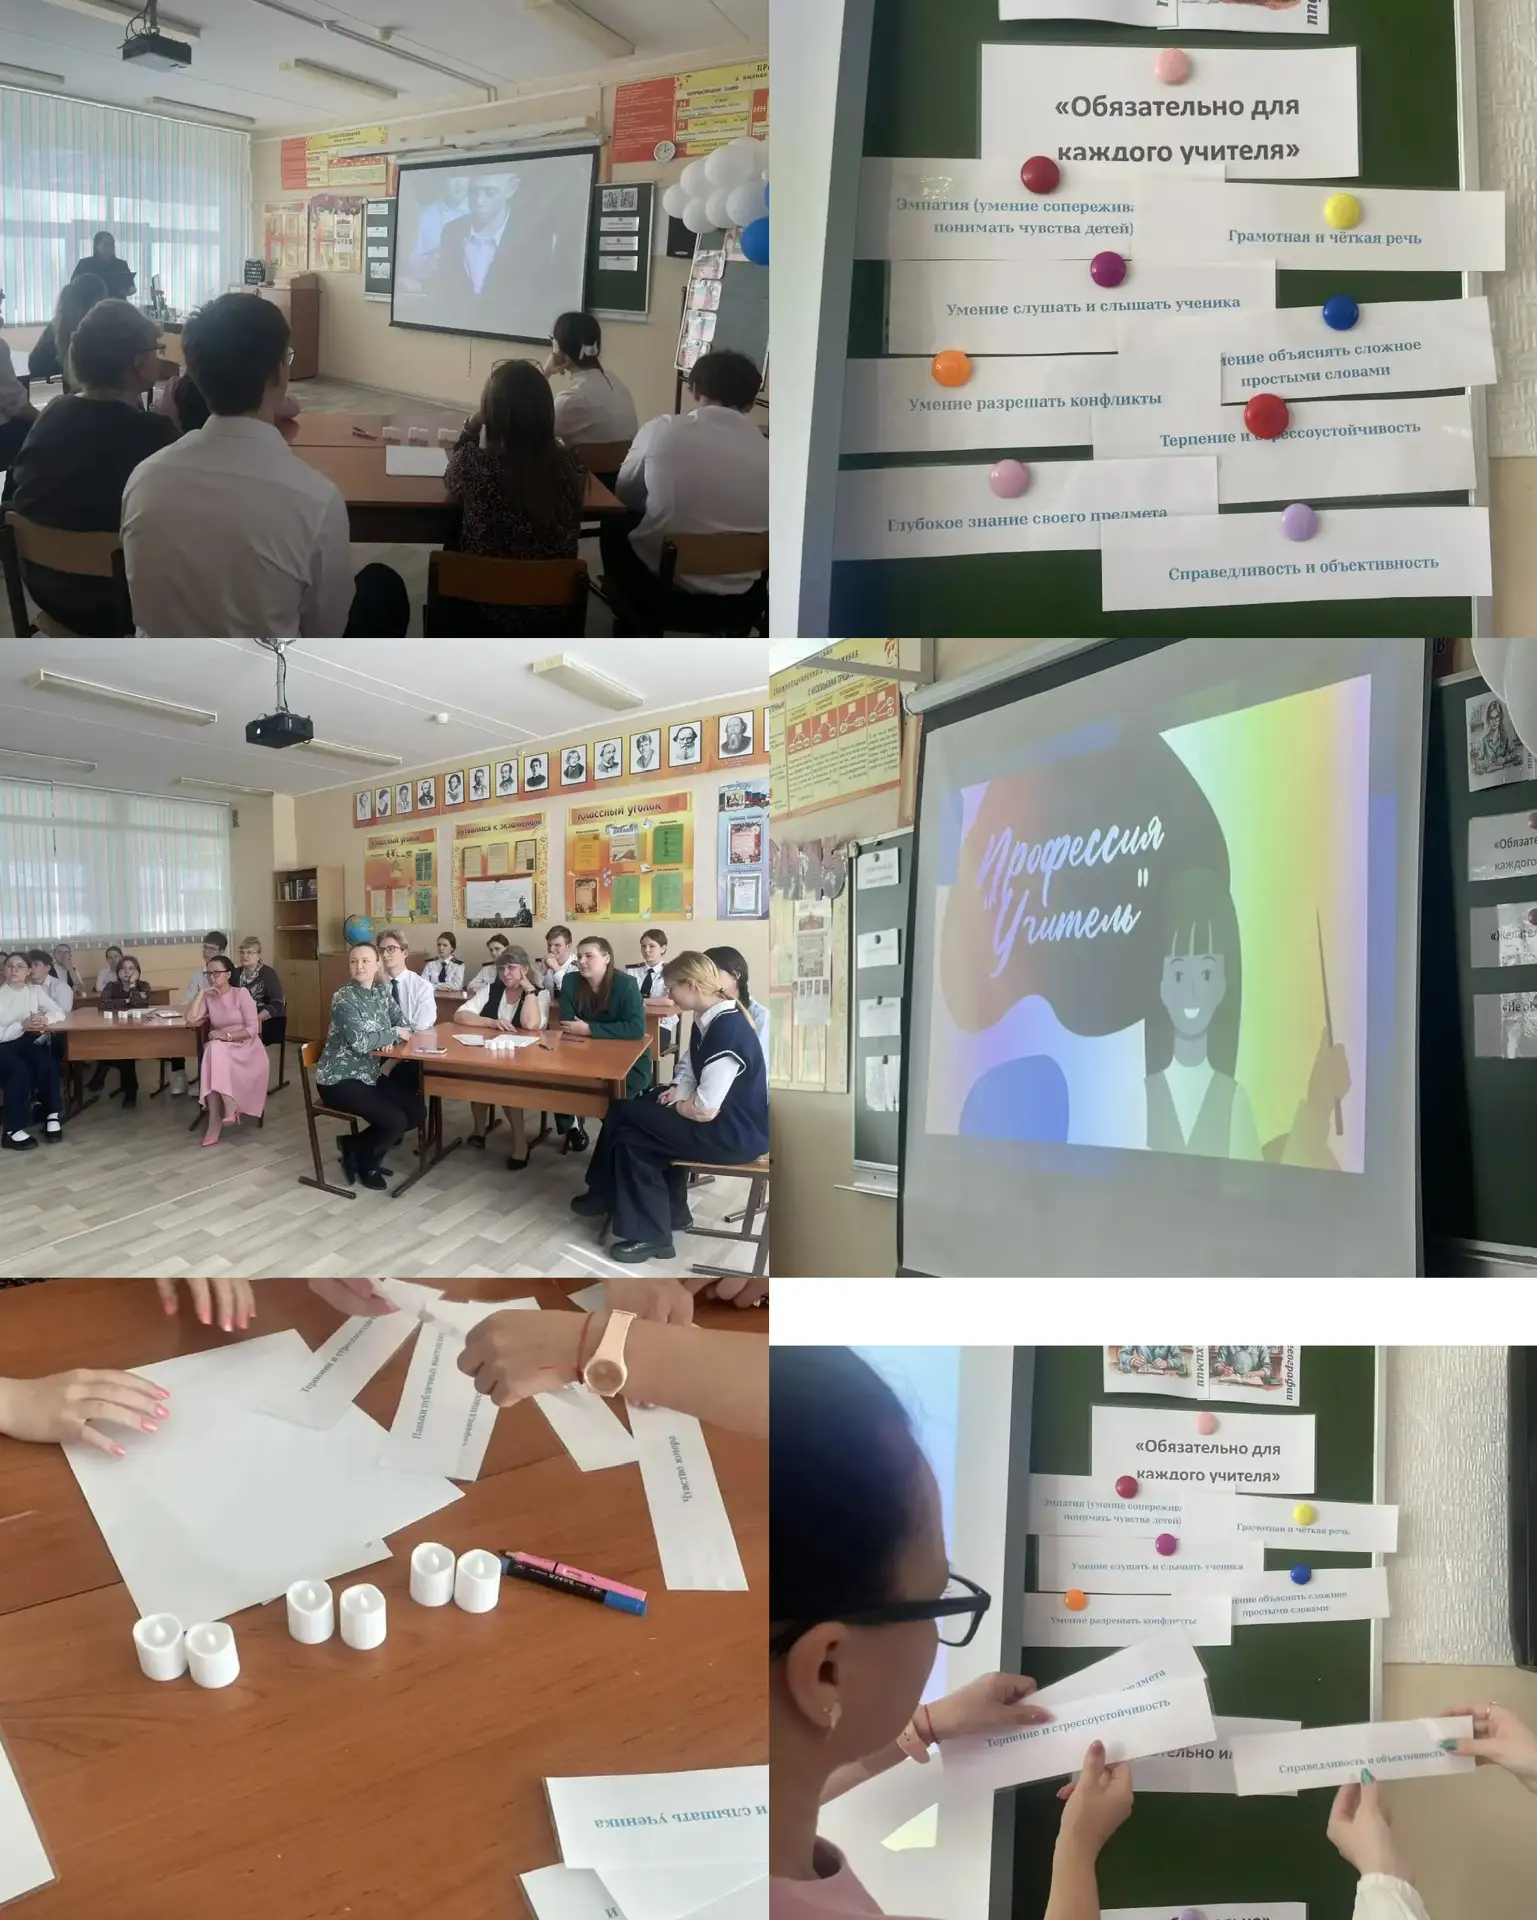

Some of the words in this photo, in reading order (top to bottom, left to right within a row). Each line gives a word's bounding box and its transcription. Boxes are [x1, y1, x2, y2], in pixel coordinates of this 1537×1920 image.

[1055, 95, 1245, 118] «Обязательно
[1250, 99, 1300, 121] для
[1057, 145, 1173, 163] каждого
[1179, 143, 1301, 165] учителя»
[896, 198, 970, 213] Эмпатия
[973, 199, 1039, 215] (умение
[1043, 202, 1135, 215] сопережив
[933, 222, 1014, 235] понимать
[1019, 223, 1081, 236] чувства
[1084, 221, 1135, 237] детей)
[1228, 229, 1311, 246] Грамотная
[1315, 232, 1325, 244] и
[1329, 230, 1382, 245] чёткая
[1385, 233, 1423, 247] речь
[946, 303, 1009, 317] Умение
[1012, 302, 1082, 317] слушать
[1085, 302, 1096, 312] и
[1099, 299, 1172, 312] слышать
[1175, 297, 1242, 312] ученика
[1221, 353, 1266, 367] ение
[1268, 346, 1351, 363] объяснять
[1354, 339, 1422, 355] сложное
[1240, 371, 1321, 388] простыми
[1324, 365, 1391, 380] словами
[909, 396, 973, 412] Умение
[976, 394, 1067, 411] разрешать
[1070, 392, 1162, 409] конфликты
[1160, 431, 1236, 449] Терпение
[1240, 431, 1251, 442] и
[1254, 420, 1421, 443] ессоустойчивость
[887, 516, 964, 535] Глубокое
[967, 514, 1029, 529] знание
[1032, 511, 1086, 525] своего
[1168, 561, 1301, 583] Справедливость
[1305, 562, 1316, 574] и
[1319, 555, 1440, 574] объективность
[1493, 836, 1537, 849] «Обязате
[977, 815, 1165, 908] Профессия
[1136, 1439, 1249, 1455] «Обязательно
[1251, 1443, 1281, 1457] для
[1136, 1469, 1205, 1481] каждого
[1209, 1470, 1281, 1484] учителя»
[1127, 1502, 1182, 1513] сопережив
[1236, 1522, 1286, 1534] Грамотная
[1328, 1527, 1351, 1537] речь
[1071, 1562, 1108, 1571] Умение
[1110, 1562, 1150, 1572] слушать
[1152, 1563, 1159, 1571] и
[1160, 1563, 1203, 1571] слышать
[1204, 1563, 1244, 1572] ученика
[1232, 1596, 1257, 1605] ение
[1242, 1607, 1289, 1618] простыми
[1290, 1604, 1330, 1614] словами
[1050, 1616, 1088, 1625] Умение
[1089, 1616, 1141, 1626] разрешать
[986, 1729, 1040, 1749] Терпение
[1042, 1727, 1050, 1736] и
[1052, 1699, 1171, 1734] стрессоустойчивость
[1278, 1756, 1365, 1774] Справедливость
[671, 1806, 752, 1823] слышать
[755, 1804, 768, 1816] и
[593, 1812, 668, 1829] ученика
